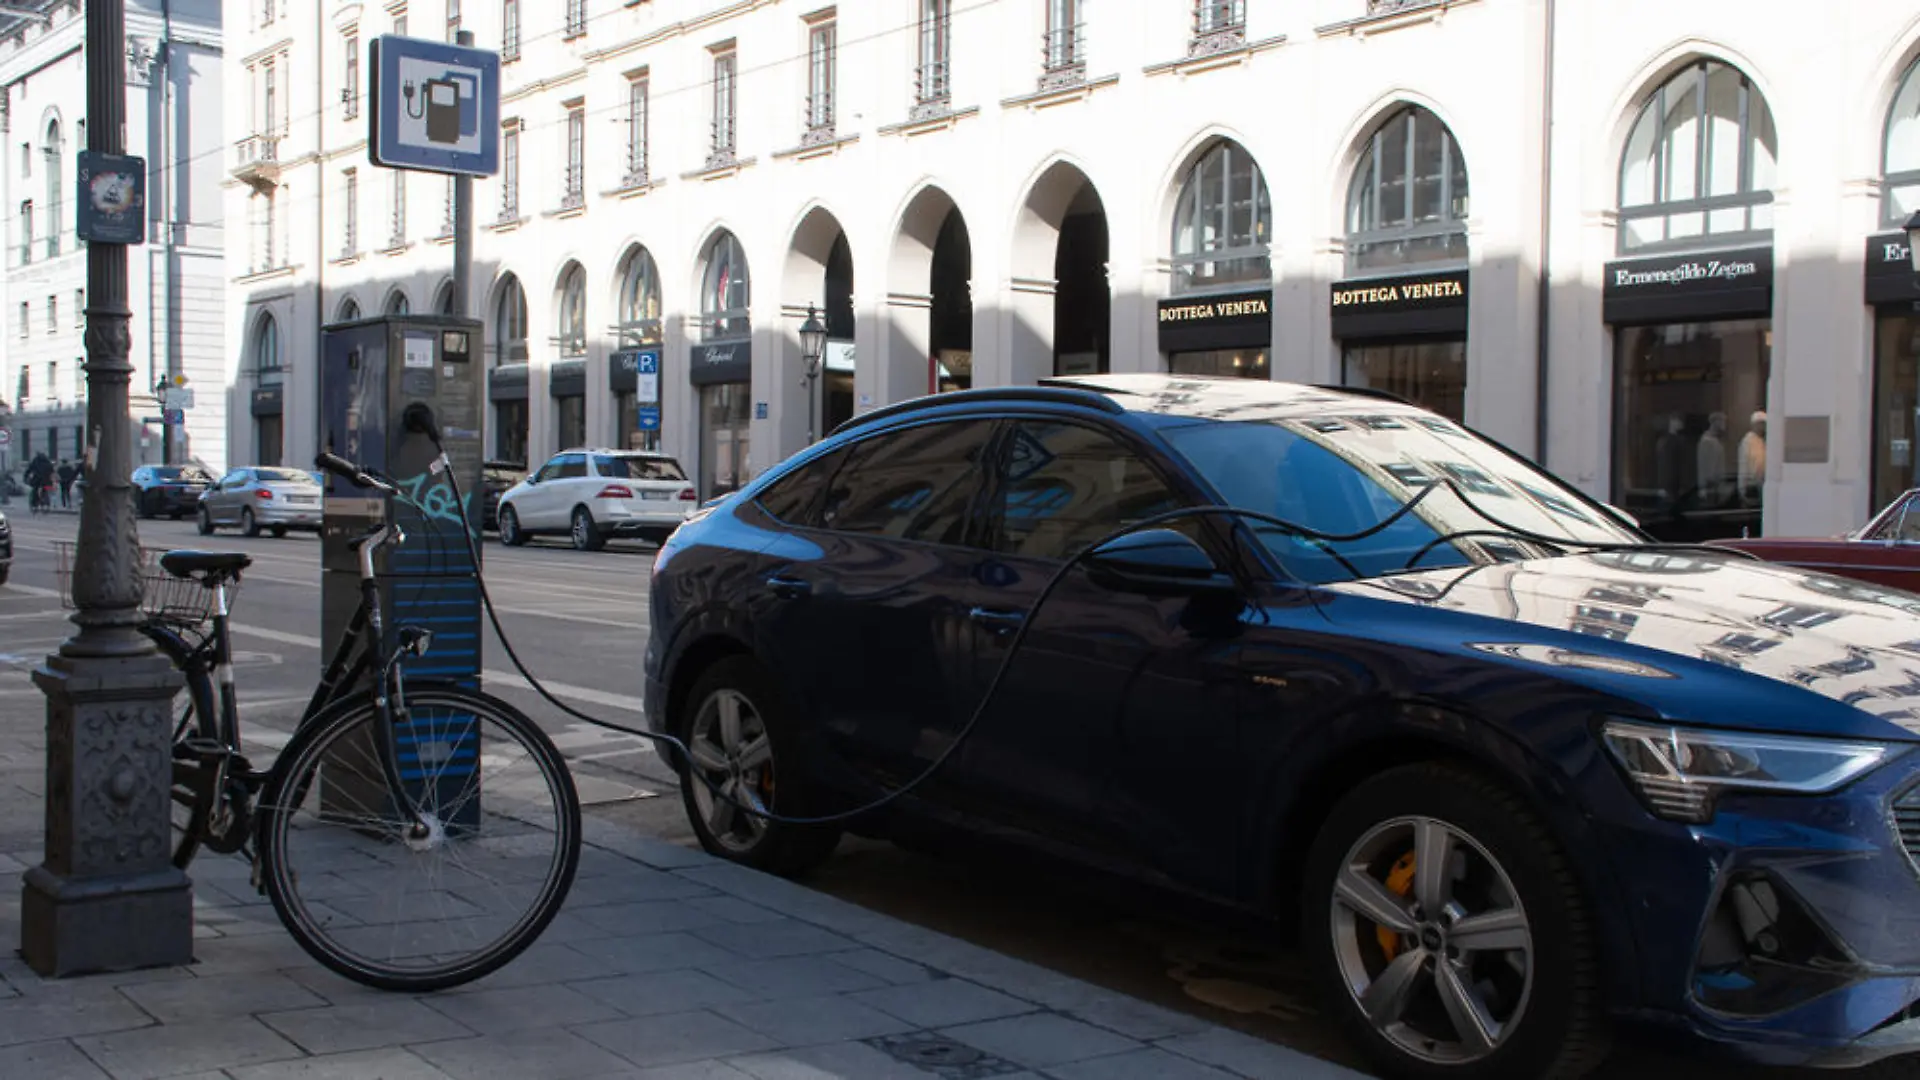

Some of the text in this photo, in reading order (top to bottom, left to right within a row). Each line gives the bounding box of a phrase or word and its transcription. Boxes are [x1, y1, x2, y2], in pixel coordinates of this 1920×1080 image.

[1615, 260, 1756, 287] Ermenegildo Zegna
[1332, 280, 1464, 306] BOTTEGA VENETA
[1160, 300, 1267, 322] BOTTEGA VENETA
